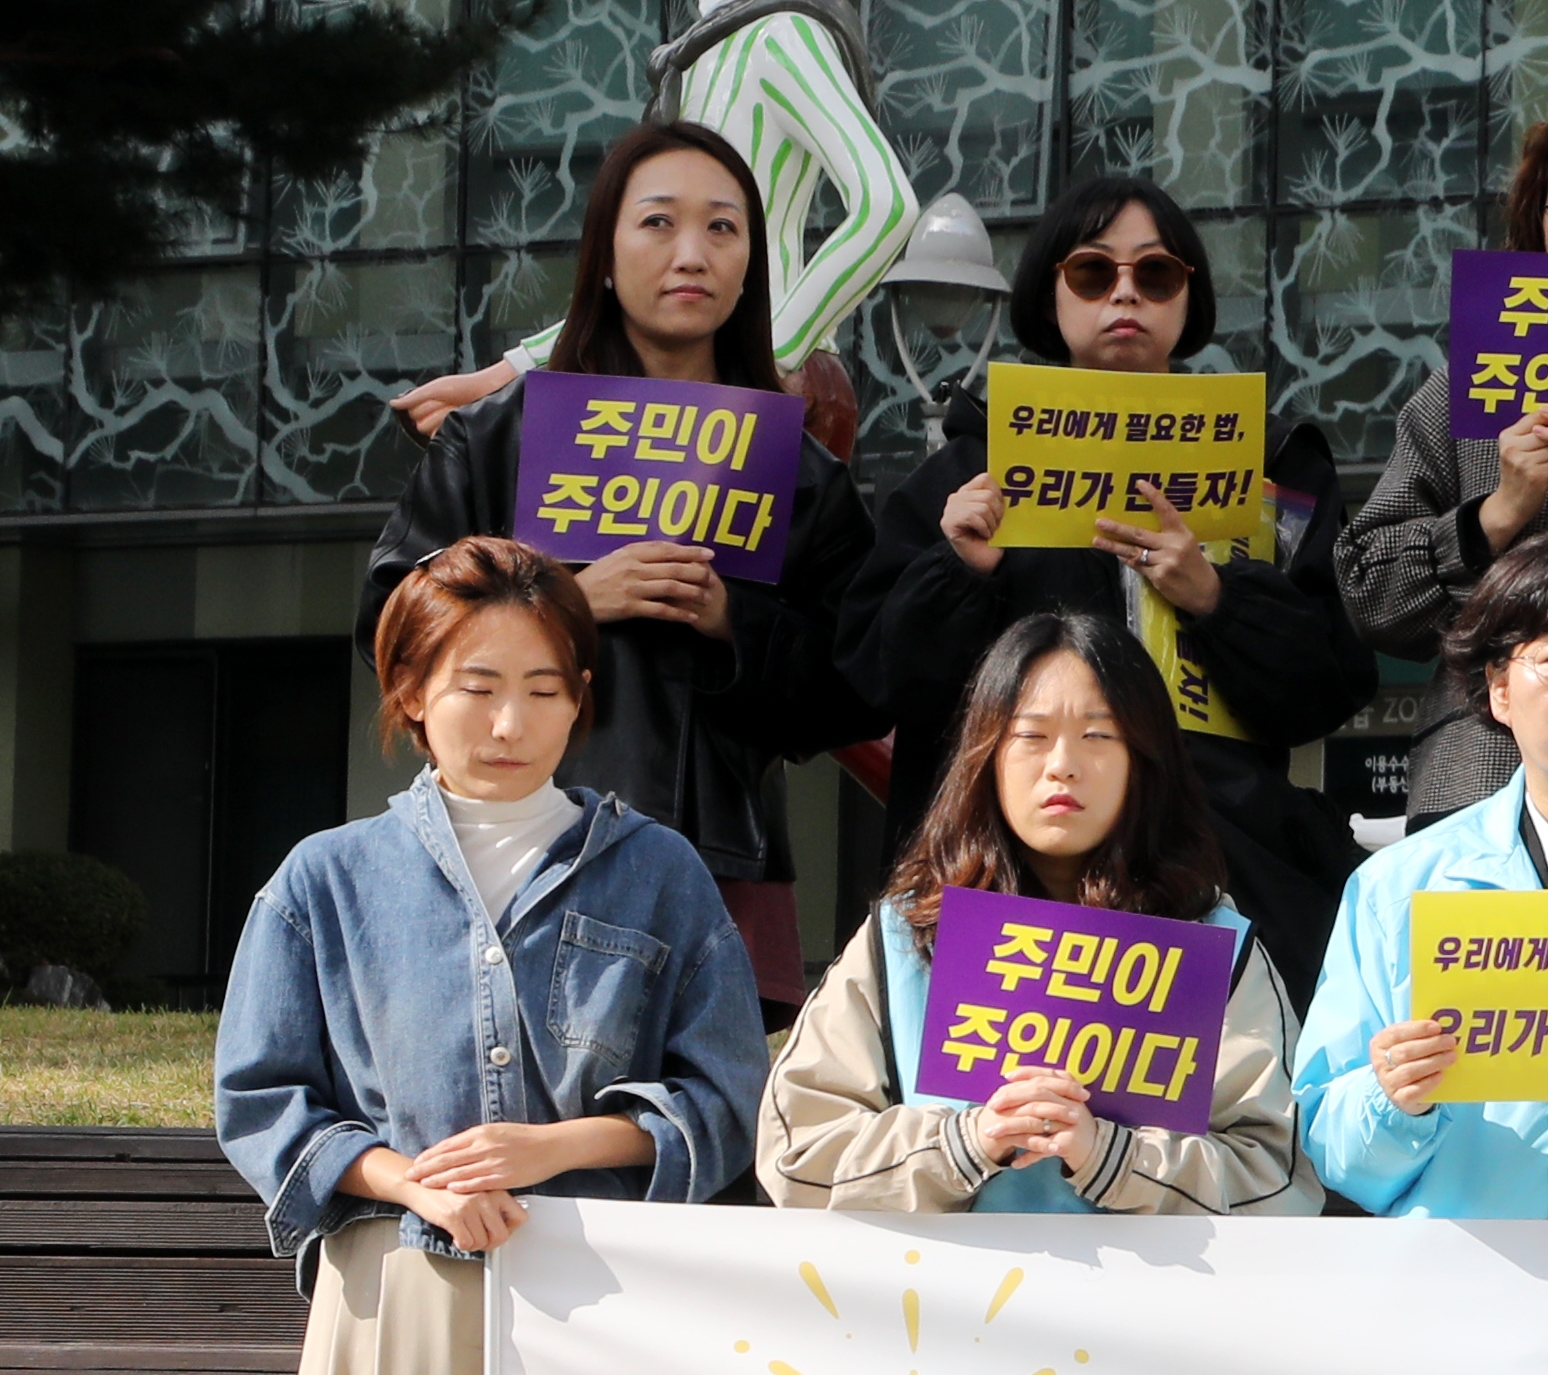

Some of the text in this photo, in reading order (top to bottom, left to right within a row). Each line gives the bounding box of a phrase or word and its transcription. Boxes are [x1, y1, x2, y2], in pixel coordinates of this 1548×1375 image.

[577, 401, 757, 470] 주민이
[1013, 407, 1245, 441] 우리에게 필요한 법,
[539, 475, 774, 550] 주인이다
[1002, 467, 1112, 509] 우리가
[984, 921, 1184, 1013] 주민이
[941, 1002, 1200, 1102] 주인이다
